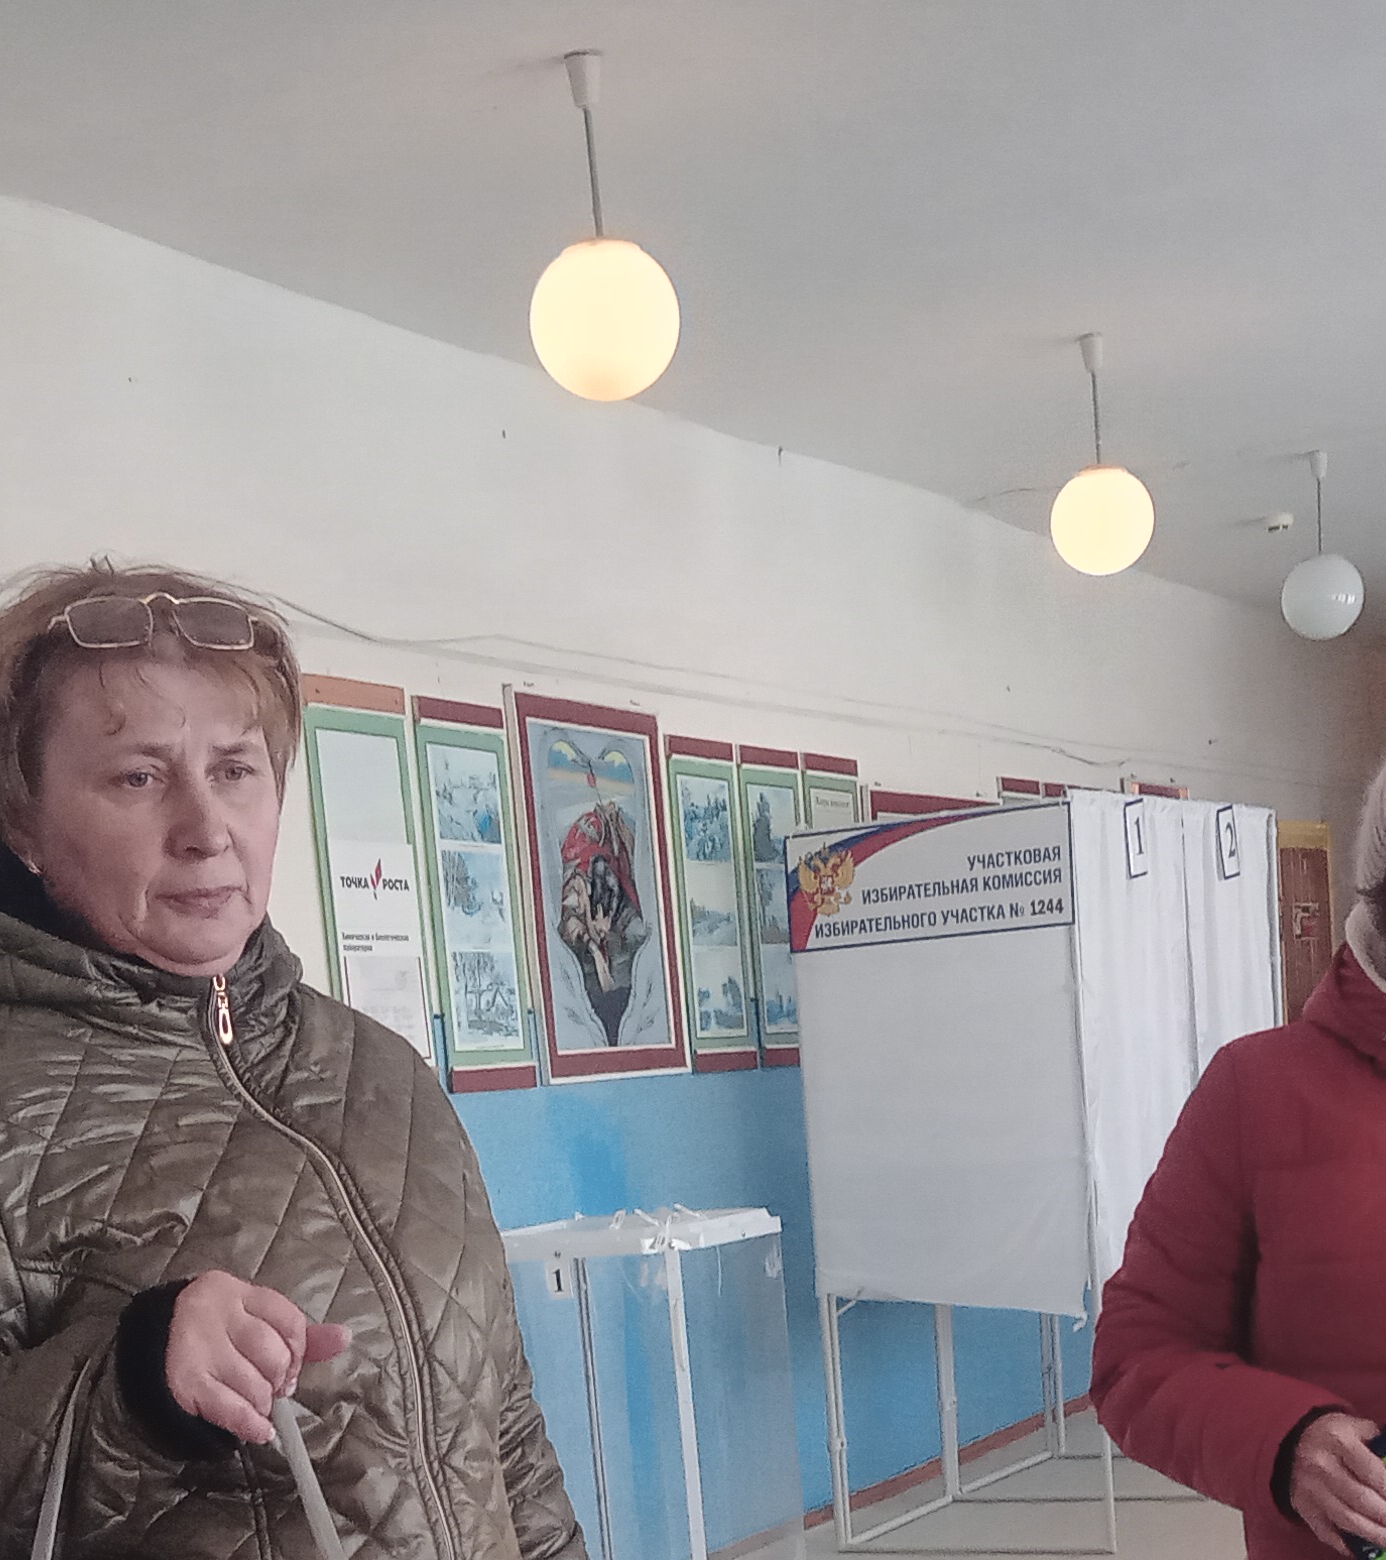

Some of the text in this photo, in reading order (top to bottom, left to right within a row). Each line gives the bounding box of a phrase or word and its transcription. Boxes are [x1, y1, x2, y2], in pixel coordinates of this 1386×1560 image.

[1134, 816, 1145, 856] 1
[1224, 822, 1236, 859] 2
[967, 846, 1062, 872] УЧАСТКОВАЯ
[340, 876, 410, 891] ТОЧКА РОСТА
[861, 868, 1063, 905] ИЗБИРАТЕЛЬНАЯ КОМИССИЯ
[814, 911, 937, 939] ИЗБИРАТЕЛЬНОГО
[942, 905, 1007, 926] УЧАСТКА
[1030, 898, 1065, 916] 1244
